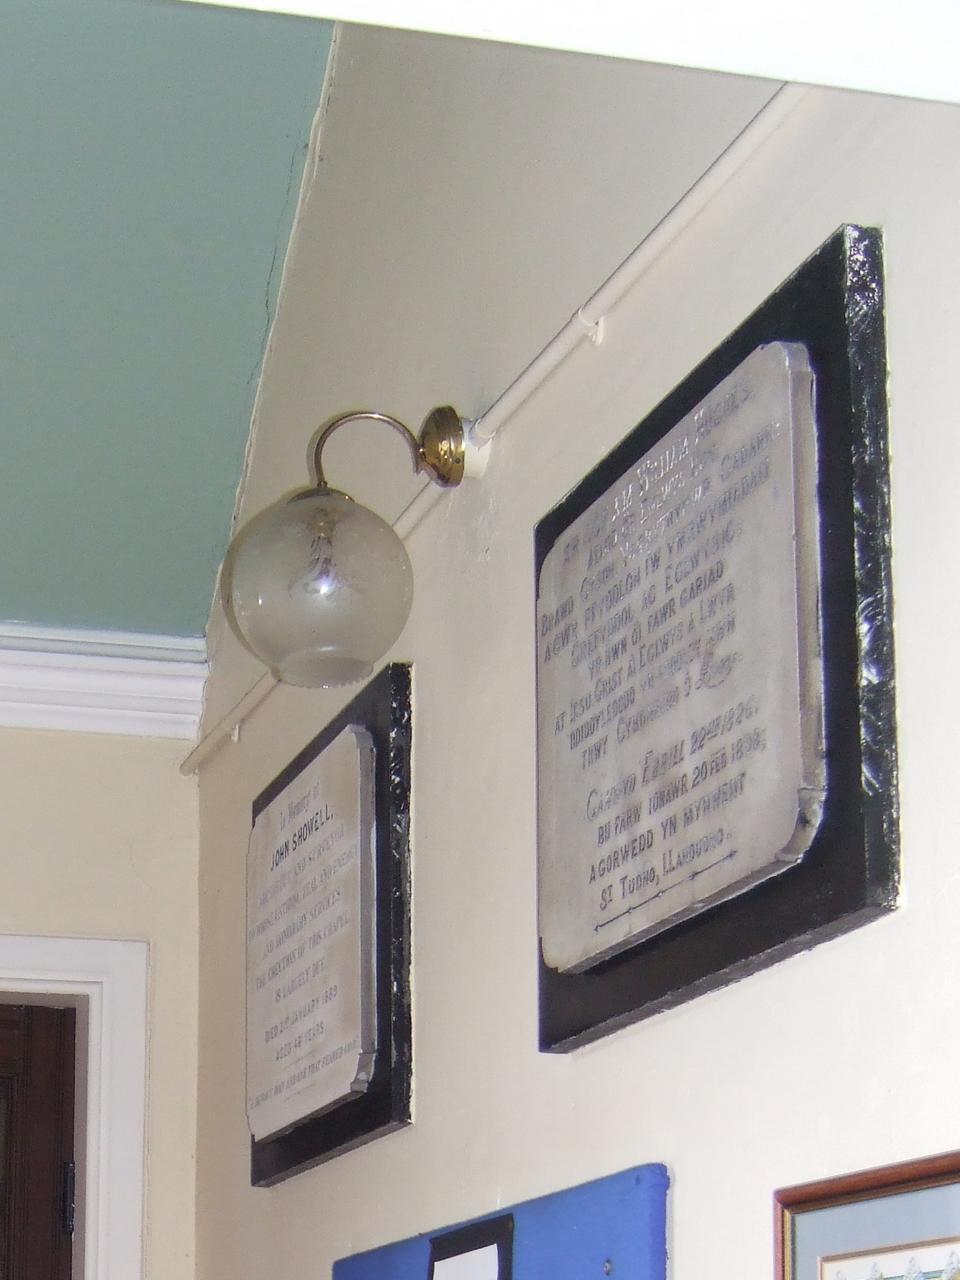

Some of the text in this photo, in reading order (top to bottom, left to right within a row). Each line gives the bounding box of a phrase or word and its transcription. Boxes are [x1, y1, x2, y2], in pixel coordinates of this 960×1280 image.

[269, 804, 334, 872] JOHN SHOWELL,
[660, 813, 678, 839] YN
